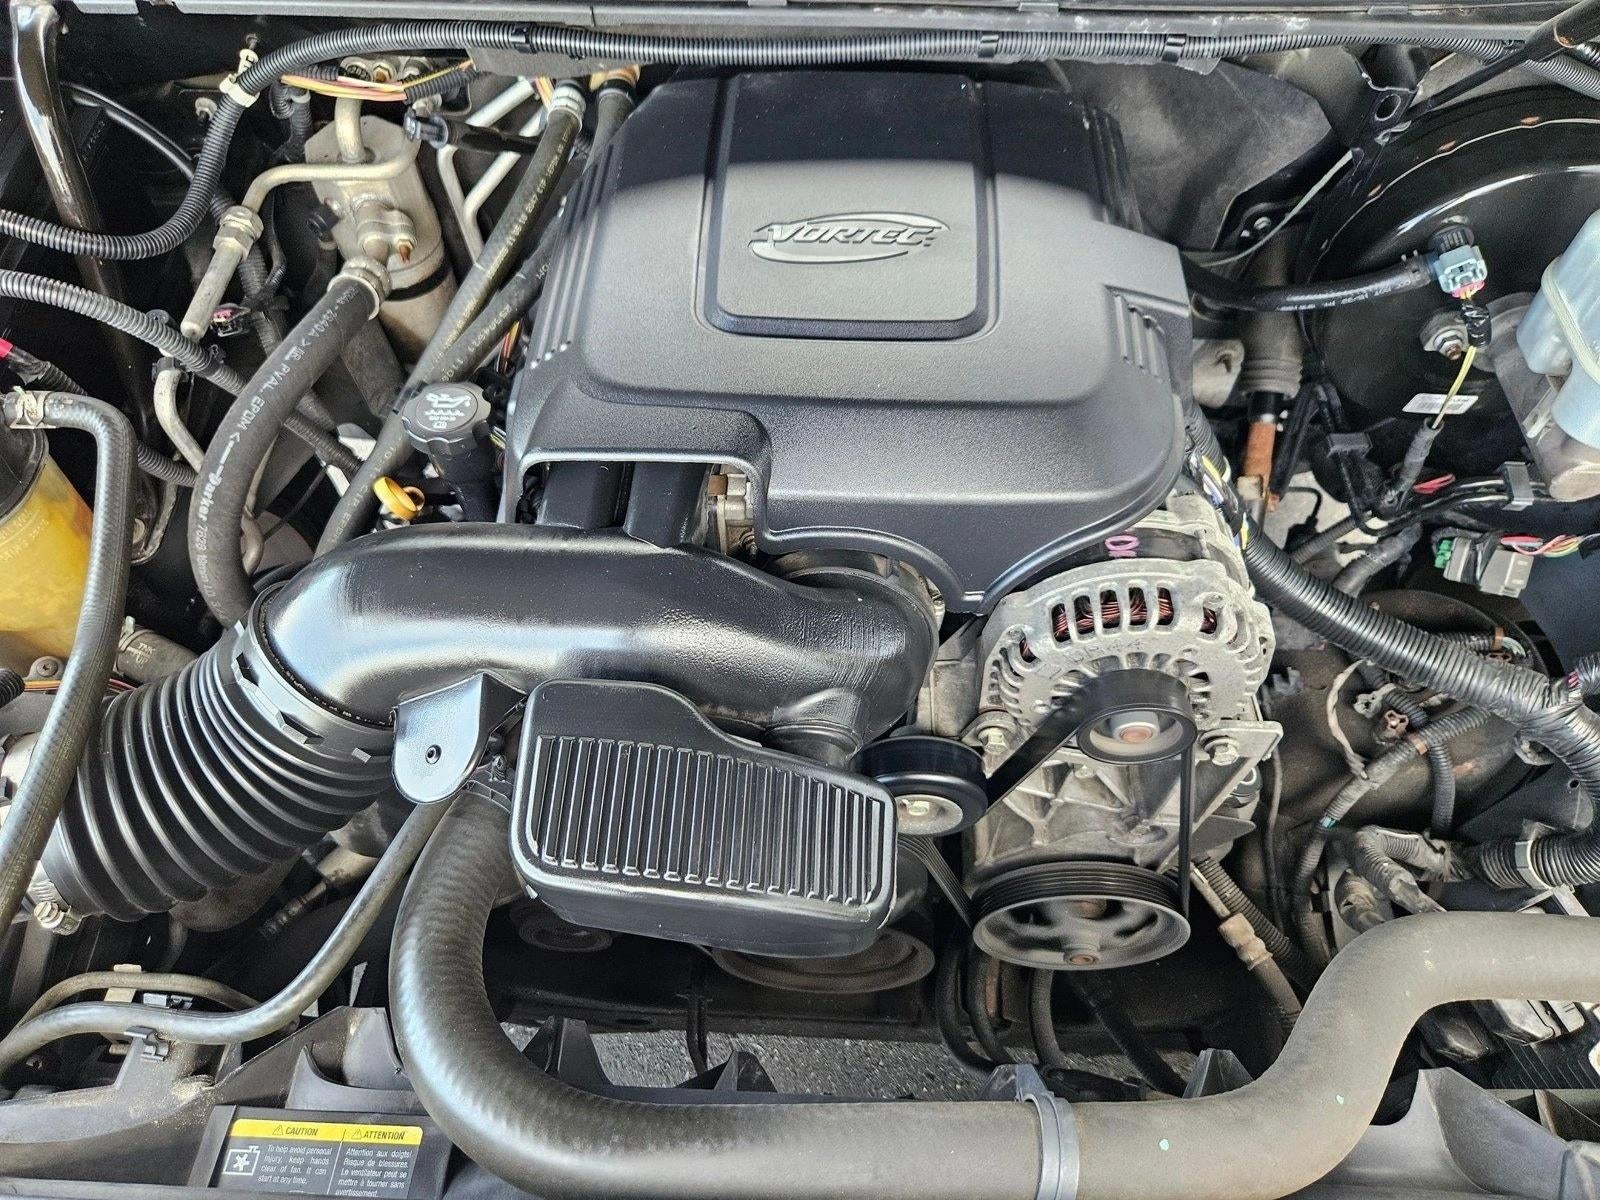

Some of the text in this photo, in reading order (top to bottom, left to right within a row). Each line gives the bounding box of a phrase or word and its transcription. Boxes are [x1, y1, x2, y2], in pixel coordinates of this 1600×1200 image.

[766, 222, 937, 247] VORTEC
[285, 1127, 318, 1136] CAUTION
[362, 1131, 405, 1140] ATTENTION
[289, 1146, 306, 1154] avoid
[306, 1147, 332, 1155] personal
[346, 1148, 373, 1157] Attention
[391, 1150, 413, 1159] doigts!
[289, 1156, 304, 1164] keep
[310, 1157, 329, 1165] hands
[343, 1158, 364, 1166] Risque
[368, 1159, 375, 1167] de
[341, 1168, 348, 1176] Le
[351, 1169, 382, 1177] ventilateur
[384, 1170, 398, 1179] peut
